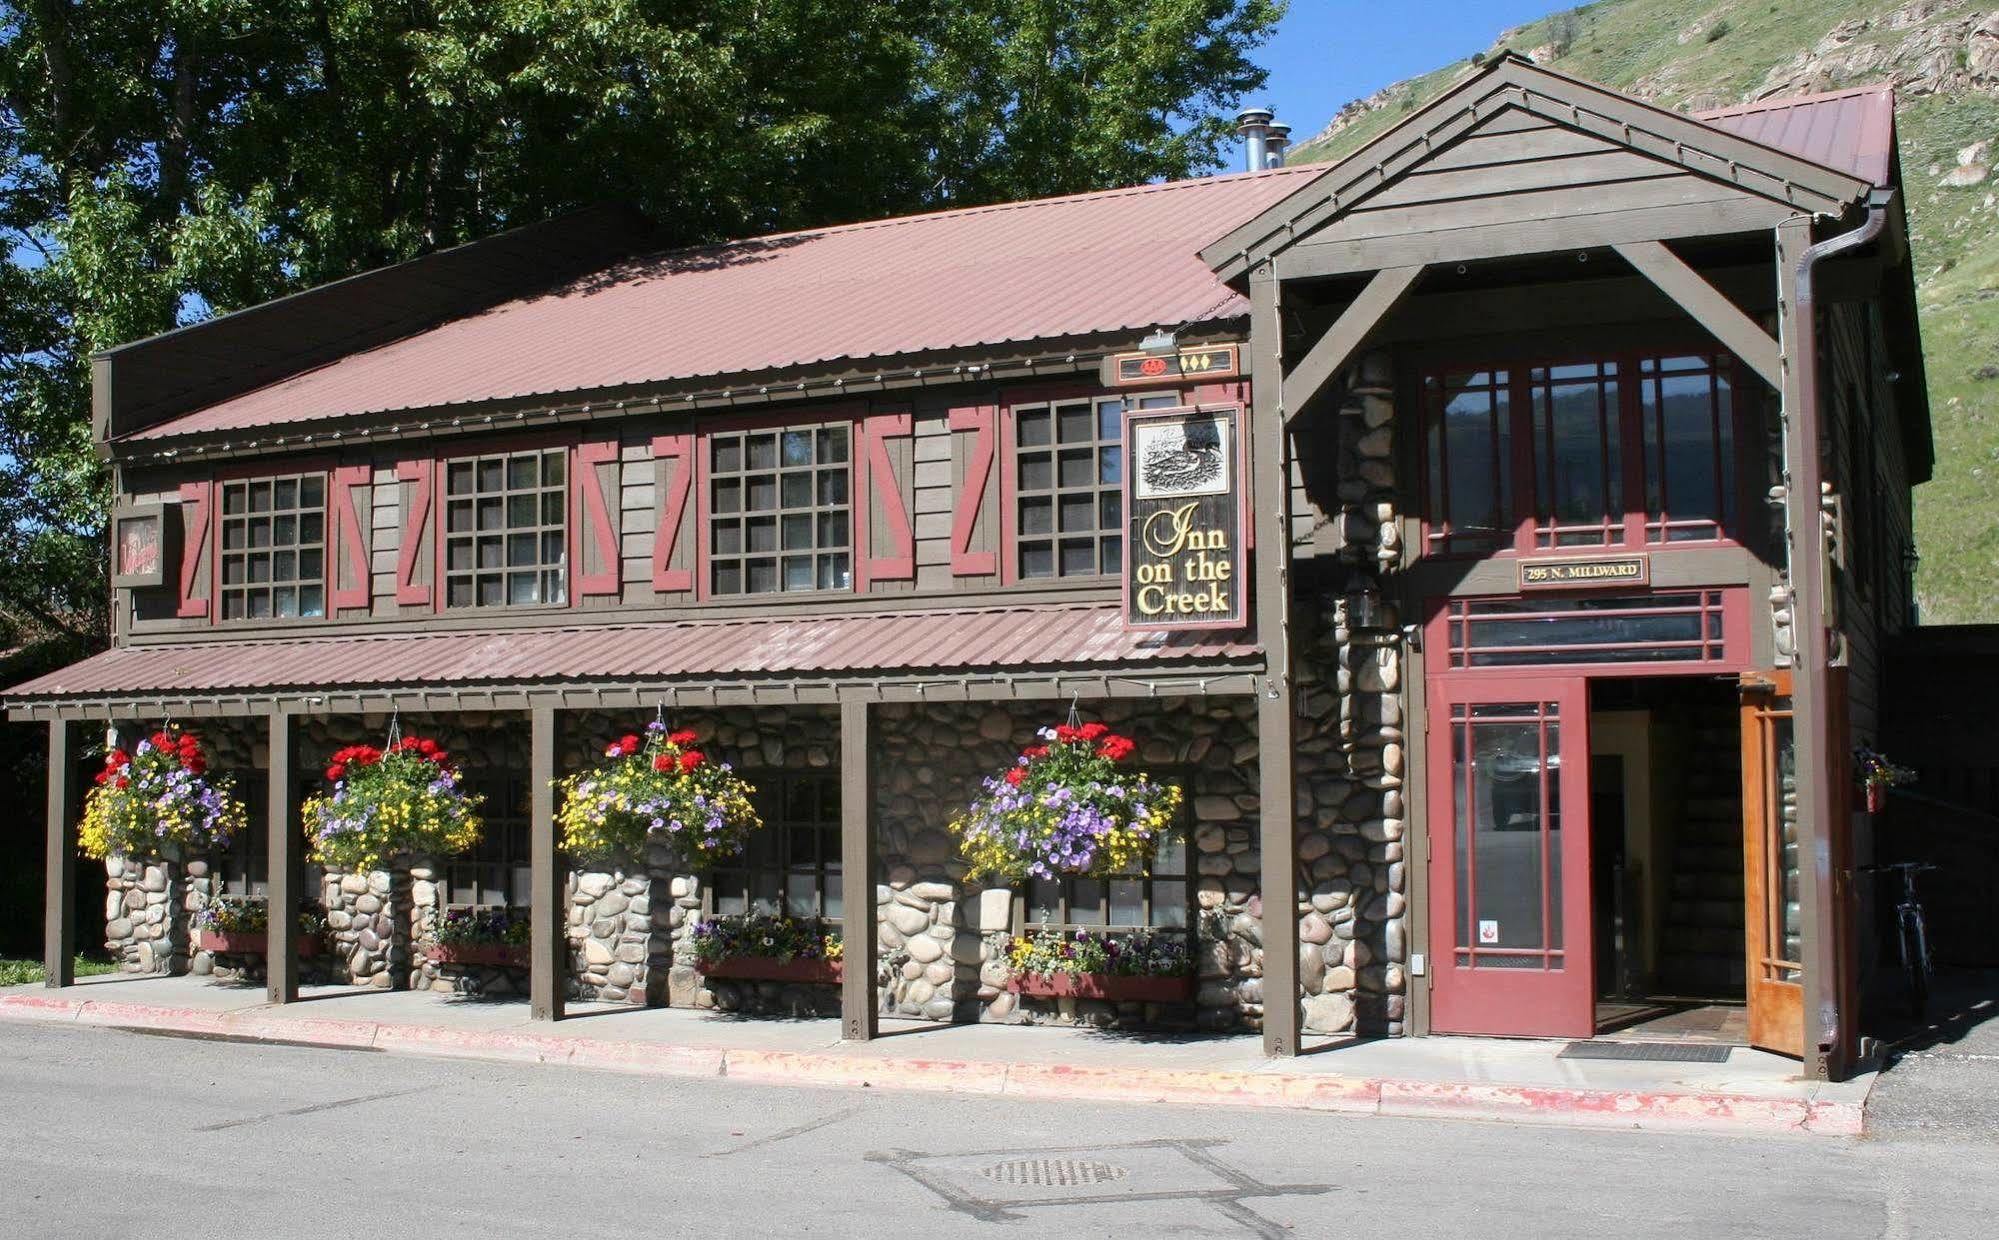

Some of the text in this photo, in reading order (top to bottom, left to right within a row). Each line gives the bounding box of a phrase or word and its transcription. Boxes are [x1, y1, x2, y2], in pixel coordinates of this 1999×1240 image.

[1143, 502, 1227, 557] Inn
[1136, 551, 1231, 584] on the
[1528, 564, 1637, 581] 295 N. MILLWARD
[1137, 585, 1229, 615] Creek
